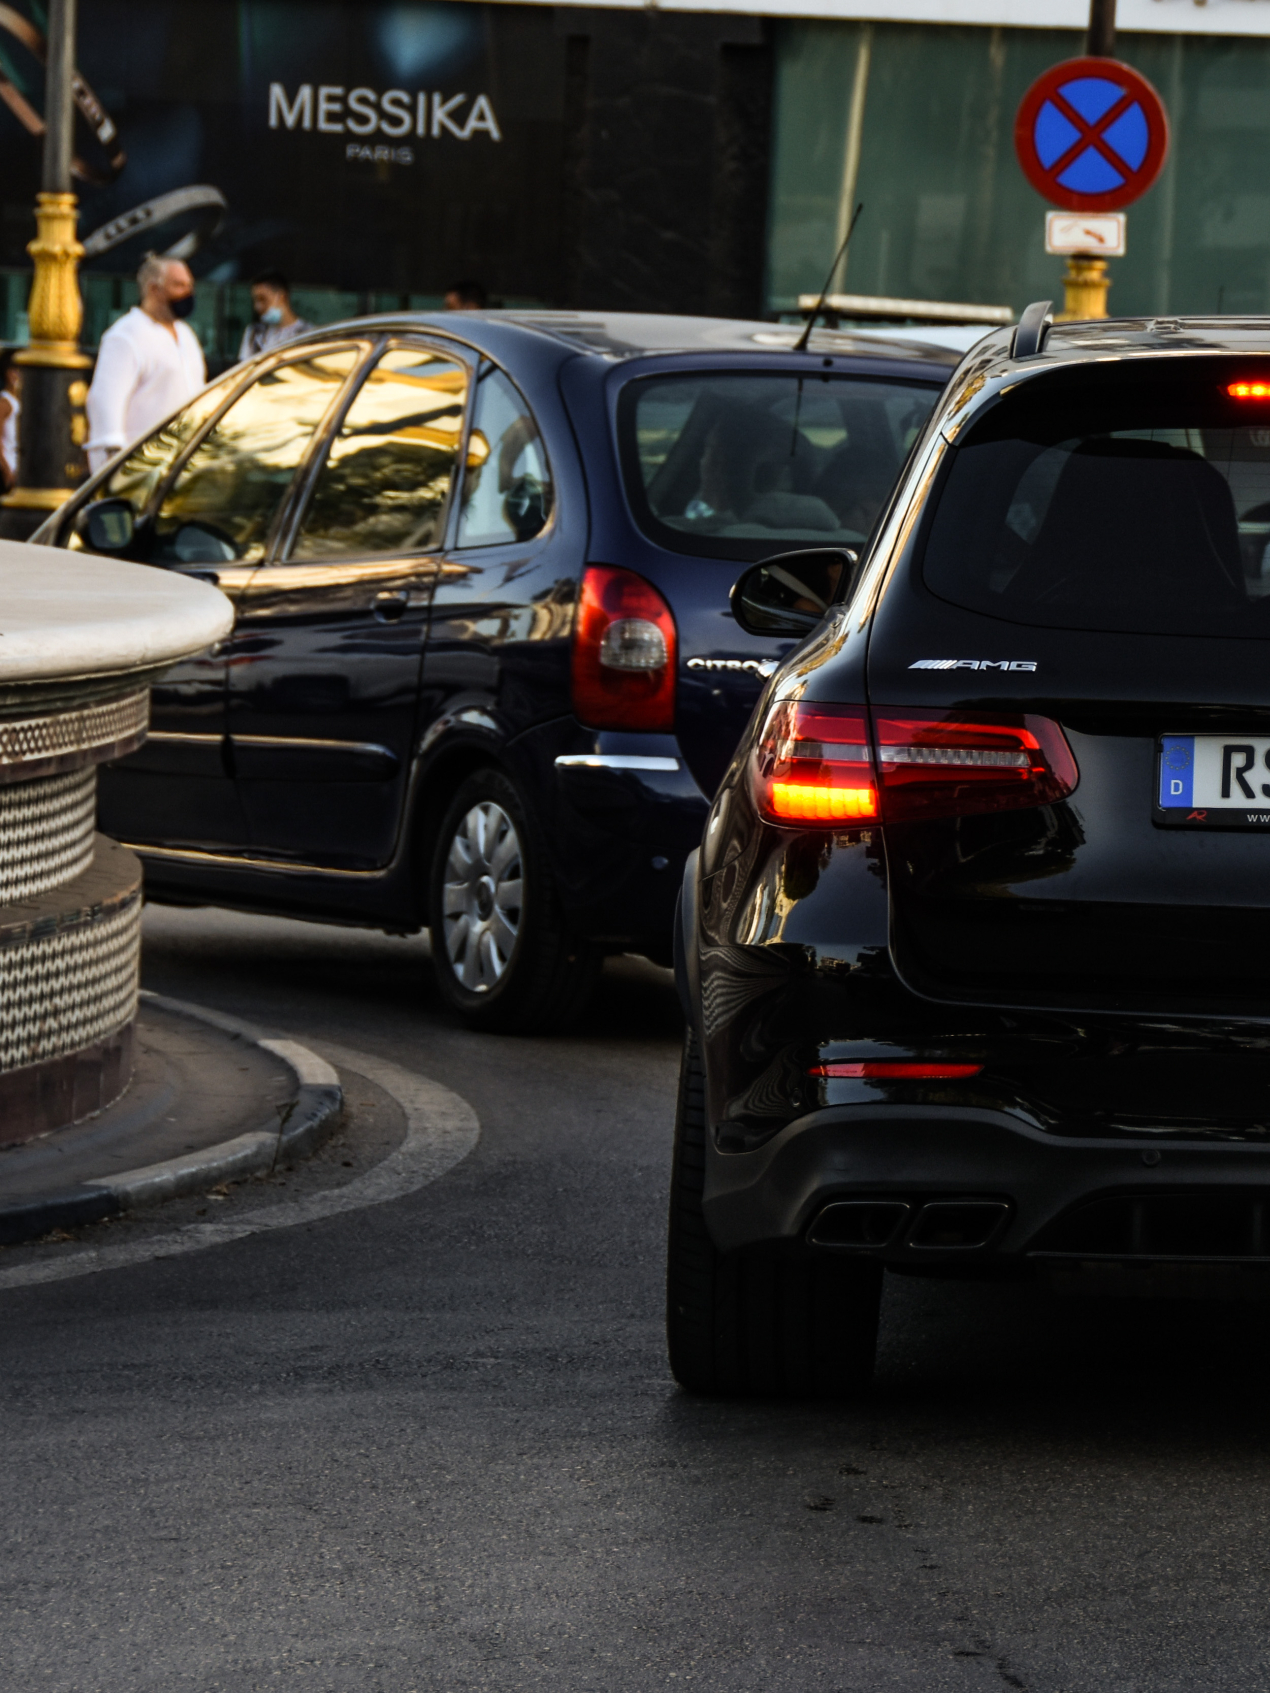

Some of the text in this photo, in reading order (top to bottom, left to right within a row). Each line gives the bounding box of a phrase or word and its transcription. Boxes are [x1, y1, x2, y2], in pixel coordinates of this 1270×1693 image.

[267, 82, 502, 141] MESSIKA
[346, 144, 414, 165] PARIS
[950, 659, 1038, 672] AMG
[1170, 779, 1183, 795] D
